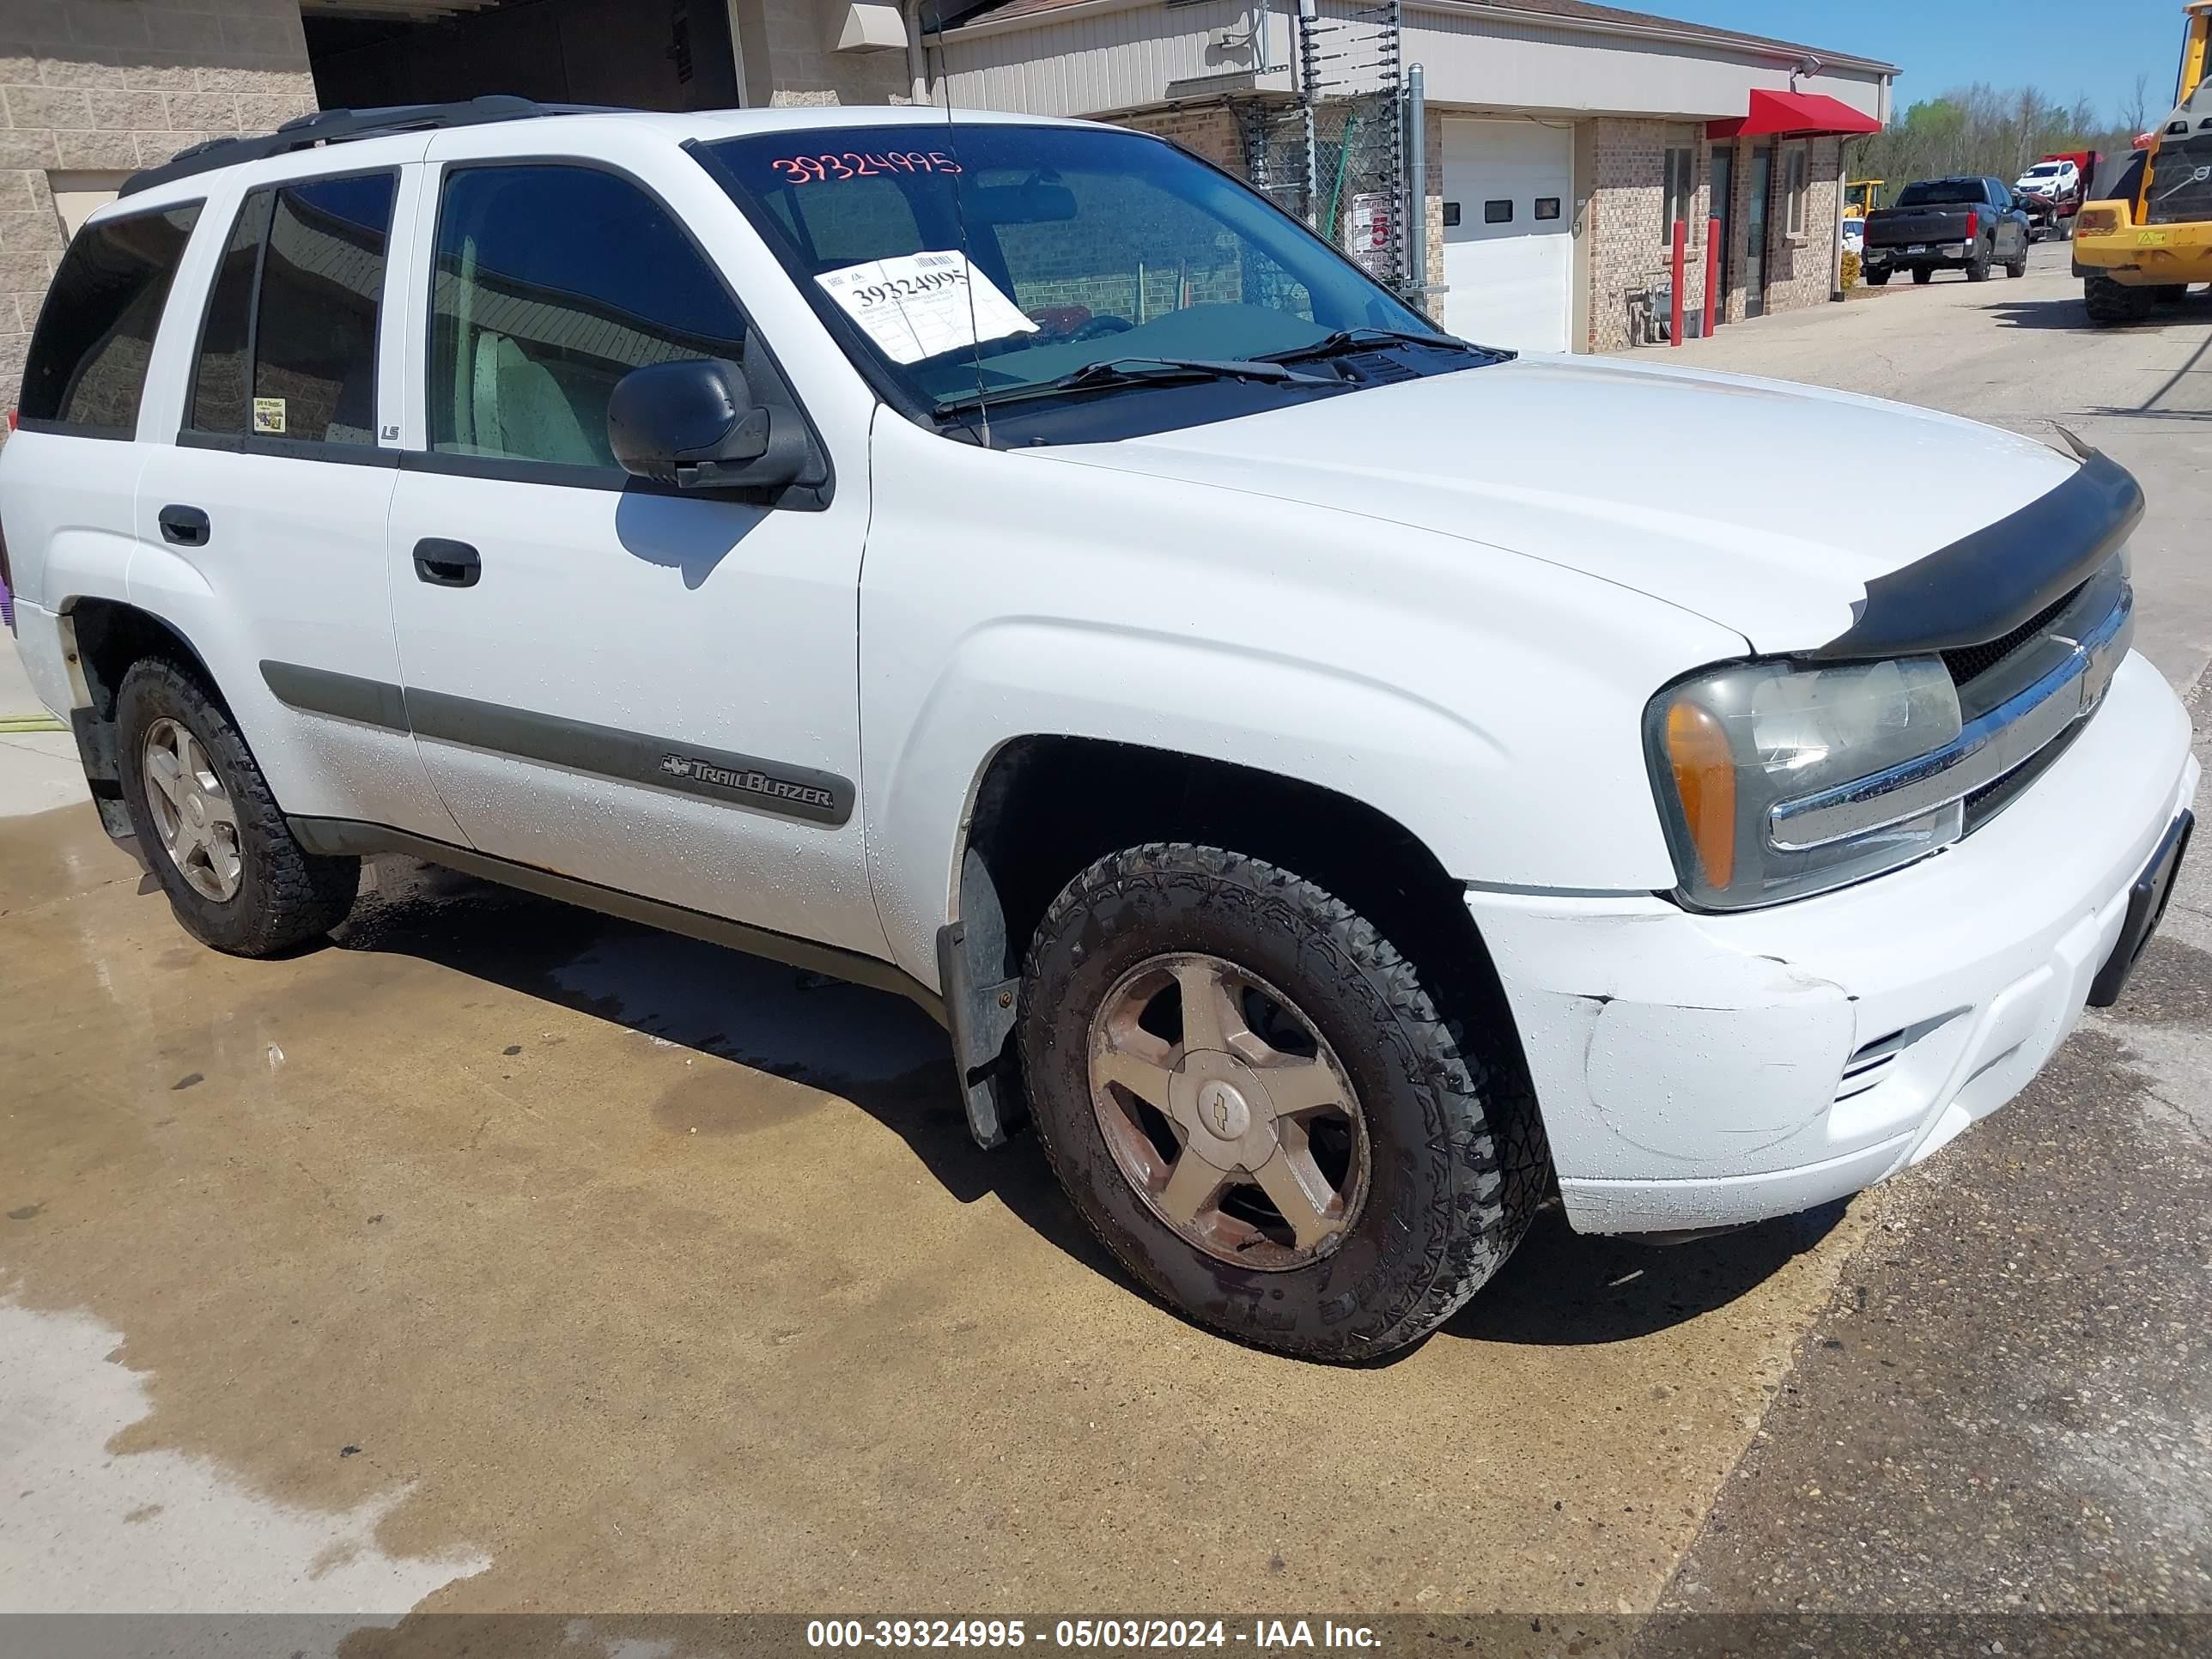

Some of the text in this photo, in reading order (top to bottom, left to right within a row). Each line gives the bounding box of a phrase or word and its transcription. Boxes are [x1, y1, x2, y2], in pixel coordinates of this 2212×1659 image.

[771, 151, 963, 185] 39324995
[1372, 216, 1389, 246] 5
[852, 269, 969, 307] 39324995
[380, 425, 400, 441] LS
